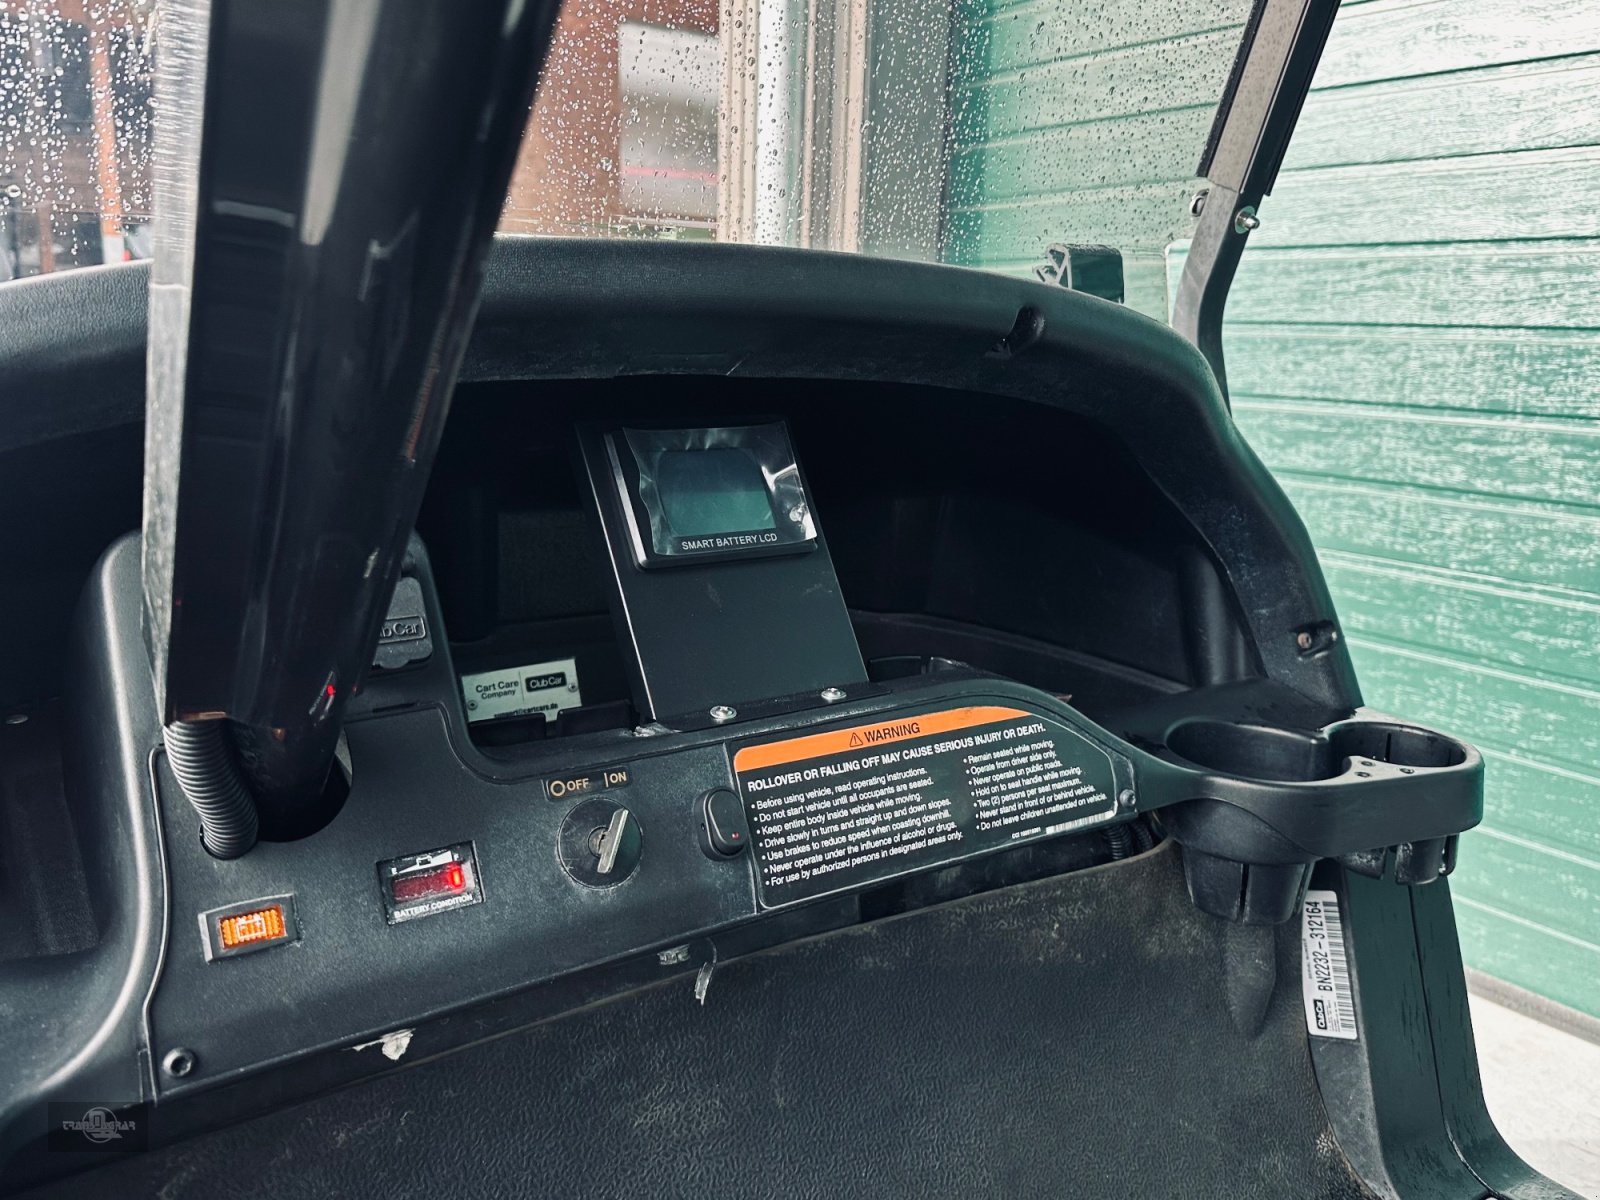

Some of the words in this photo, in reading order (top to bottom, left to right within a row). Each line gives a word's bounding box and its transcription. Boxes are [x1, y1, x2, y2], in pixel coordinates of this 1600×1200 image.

[682, 538, 714, 550] SMART
[716, 536, 758, 547] BATTERY
[760, 533, 778, 542] LCD
[476, 682, 496, 693] Cart
[498, 680, 519, 690] Care
[482, 688, 516, 700] Company
[864, 722, 920, 742] WARNING
[748, 772, 802, 792] ROLLOVER
[804, 768, 819, 780] OR
[820, 760, 860, 778] FALLING
[862, 756, 880, 768] OFF
[881, 752, 900, 764] MAY
[902, 746, 934, 760] CAUSE
[934, 737, 974, 754] SERIOUS
[974, 730, 1002, 746] INJURY
[1003, 729, 1016, 740] OR
[1016, 723, 1046, 736] DEATH.
[968, 752, 992, 764] Remain
[993, 746, 1014, 759] seated
[1014, 744, 1030, 754] while
[1031, 740, 1054, 750] moving.
[970, 763, 996, 776] Operate
[996, 760, 1010, 769] from
[1011, 756, 1028, 766] driver
[1030, 752, 1042, 762] side
[1043, 750, 1056, 759] only.
[566, 778, 589, 791] OFF
[610, 772, 627, 784] ON
[972, 776, 992, 786] Never
[992, 770, 1016, 782] operate
[1016, 768, 1024, 776] on
[1026, 764, 1044, 776] public
[1044, 760, 1062, 770] roads.
[975, 788, 990, 798] Hold
[1008, 780, 1021, 790] seat
[1022, 775, 1042, 786] handle
[1043, 772, 1059, 780] while
[1059, 766, 1082, 777] moving.
[756, 798, 782, 810] Before
[784, 794, 805, 803] using
[805, 787, 834, 796] vehicle,
[835, 781, 852, 793] read
[852, 776, 886, 790] operating
[886, 768, 928, 782] instructions.
[759, 813, 772, 822] Do
[772, 811, 785, 820] not
[786, 806, 804, 817] start
[805, 801, 832, 812] vehicle
[832, 796, 848, 806] until
[849, 794, 858, 803] all
[859, 786, 894, 800] occupants
[896, 784, 908, 792] are
[908, 776, 934, 790] seated.
[977, 800, 990, 808] Two
[991, 796, 1000, 806] (2)
[1001, 790, 1026, 804] persons
[1026, 788, 1037, 798] per
[1038, 784, 1052, 794] seat
[1052, 778, 1082, 790] maximum.
[980, 809, 998, 820] Never
[1000, 802, 1016, 814] stand
[1018, 802, 1024, 810] in
[1024, 798, 1039, 808] front
[1040, 796, 1046, 804] of
[1054, 789, 1074, 801] behind
[1074, 785, 1096, 796] vehicle.
[762, 824, 782, 836] Keep
[784, 818, 806, 830] entire
[806, 814, 826, 825] body
[826, 809, 848, 820] inside
[849, 803, 875, 814] vehicle
[876, 798, 894, 809] while
[896, 792, 922, 804] moving.
[764, 837, 786, 848] Drive
[786, 830, 810, 841] slowly
[811, 828, 819, 837] in
[820, 824, 840, 834] turns
[840, 820, 854, 830] and
[856, 815, 882, 827] straight
[883, 812, 892, 821] up
[894, 807, 908, 818] and
[908, 803, 927, 814] down
[928, 798, 952, 810] slopes.
[980, 822, 990, 830] Do
[992, 819, 1002, 828] not
[1002, 815, 1020, 825] leave
[1020, 808, 1044, 820] children
[1044, 800, 1078, 814] unattended
[1078, 798, 1086, 806] on
[1086, 793, 1107, 804] vehicle.
[766, 850, 784, 860] Use
[784, 844, 810, 856] brakes
[812, 842, 820, 850] to
[821, 834, 847, 848] reduce
[848, 830, 870, 842] speed
[870, 824, 891, 836] when
[892, 818, 922, 830] coasting
[922, 809, 952, 823] downhill.
[770, 862, 793, 874] Never
[794, 854, 823, 868] operate
[824, 848, 846, 858] under
[847, 845, 859, 854] the
[860, 836, 892, 851] influence
[894, 834, 901, 843] of
[902, 828, 926, 840] alcohol
[928, 826, 934, 834] or
[936, 821, 957, 832] drugs.
[770, 876, 784, 886] For
[786, 872, 800, 882] use
[801, 868, 810, 879] by
[812, 858, 850, 876] authorized
[852, 852, 880, 865] persons
[881, 850, 888, 858] in
[889, 839, 926, 856] designated
[928, 836, 946, 846] areas
[948, 831, 964, 840] only.
[394, 904, 430, 918] BATTERY
[430, 894, 472, 910] CONDITION
